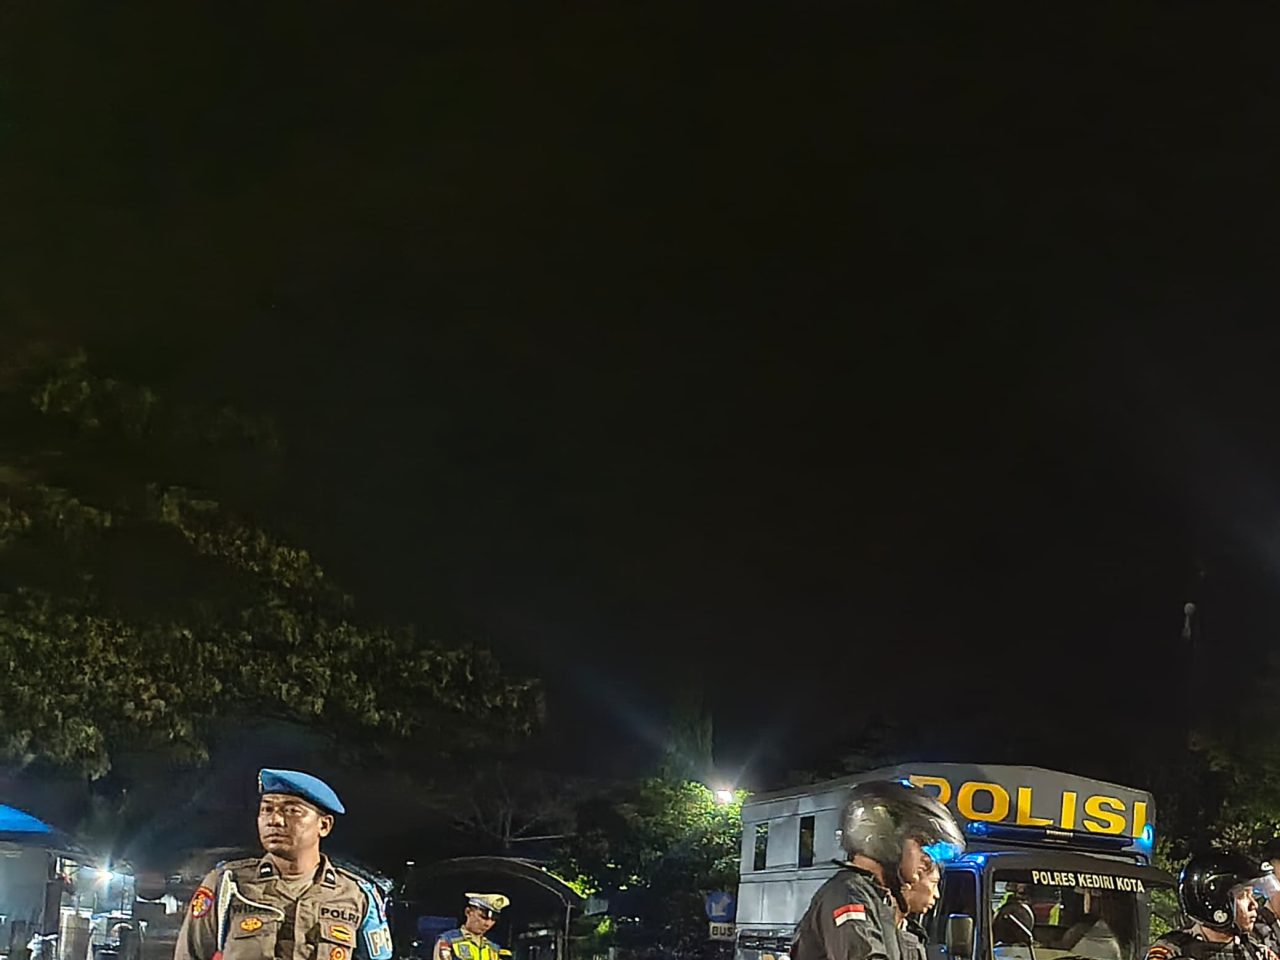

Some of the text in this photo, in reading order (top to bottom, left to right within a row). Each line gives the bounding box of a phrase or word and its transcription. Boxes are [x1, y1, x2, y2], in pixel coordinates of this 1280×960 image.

[1031, 870, 1146, 894] POLRES KEDIRI KOTA
[320, 907, 360, 924] POLRI
[711, 925, 734, 936] BUS
